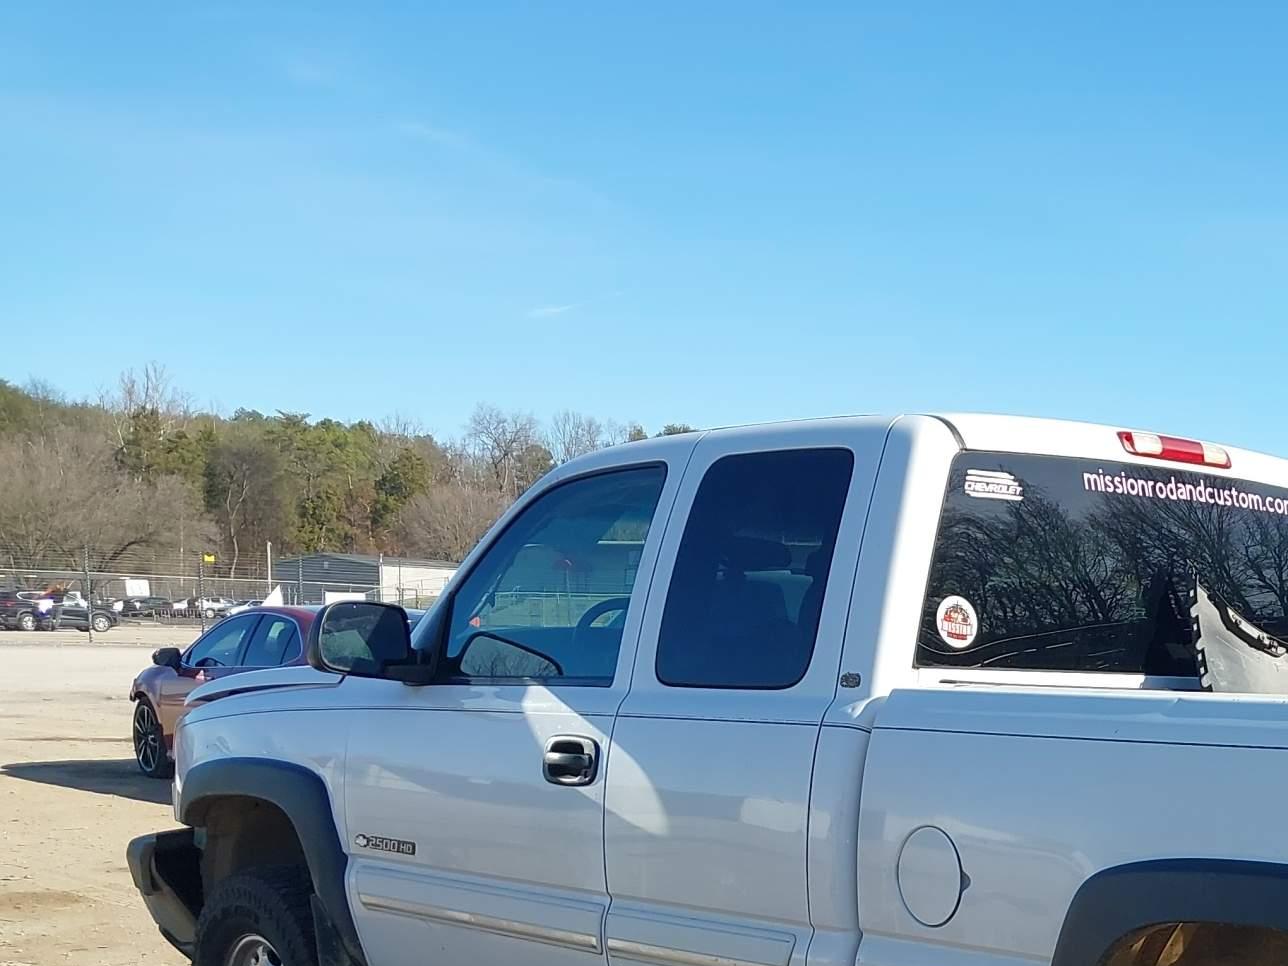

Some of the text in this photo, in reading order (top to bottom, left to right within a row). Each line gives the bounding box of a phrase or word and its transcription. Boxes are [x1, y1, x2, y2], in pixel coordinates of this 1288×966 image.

[964, 480, 1023, 496] CHEVROLET
[369, 837, 413, 853] 2500 HD
